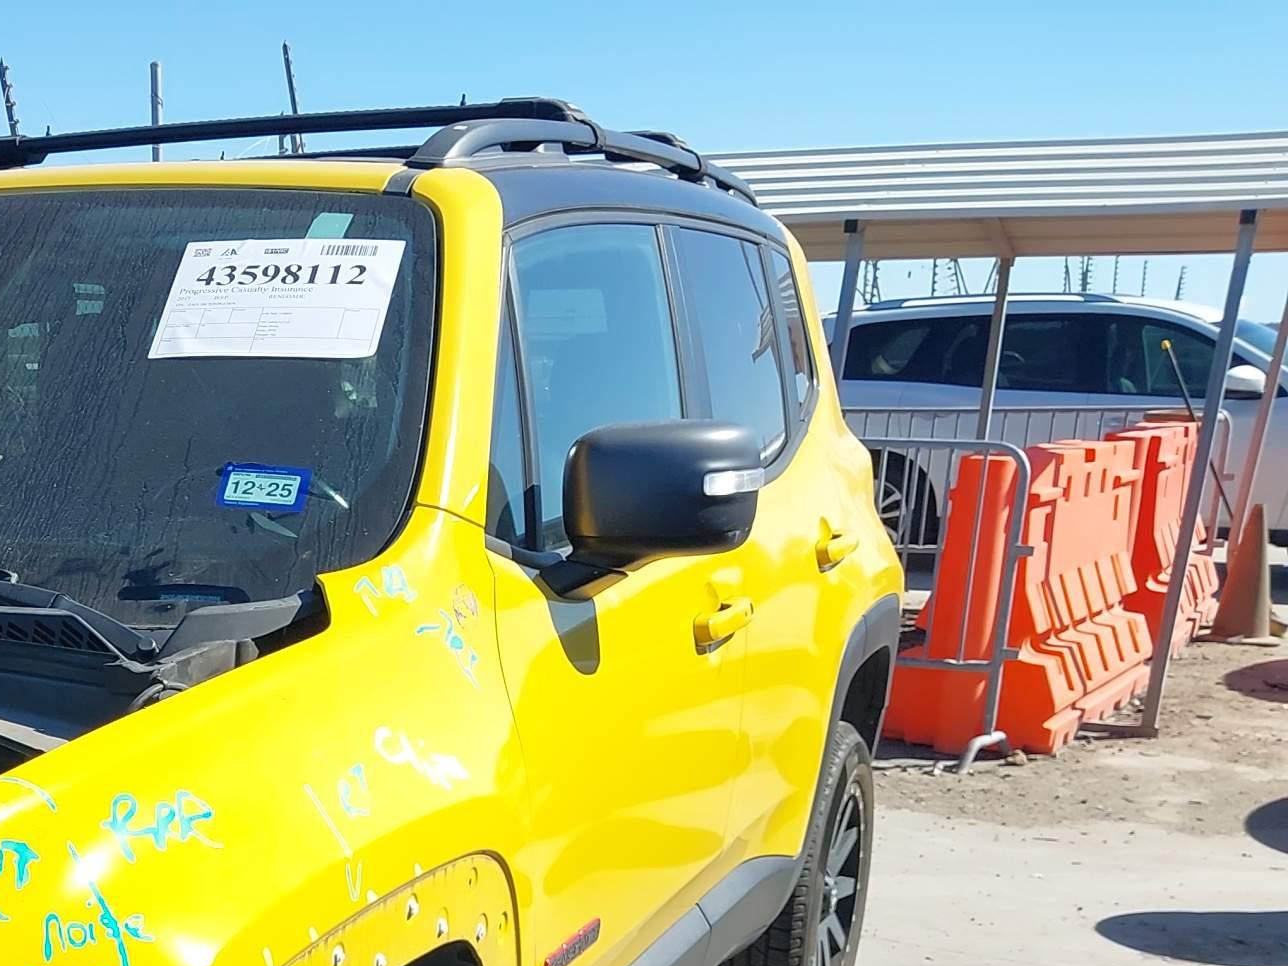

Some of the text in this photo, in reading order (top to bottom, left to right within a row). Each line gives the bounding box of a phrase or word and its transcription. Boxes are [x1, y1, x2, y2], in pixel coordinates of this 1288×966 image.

[195, 263, 368, 286] 43598112
[179, 285, 314, 296] Progressive Casualty Insurance
